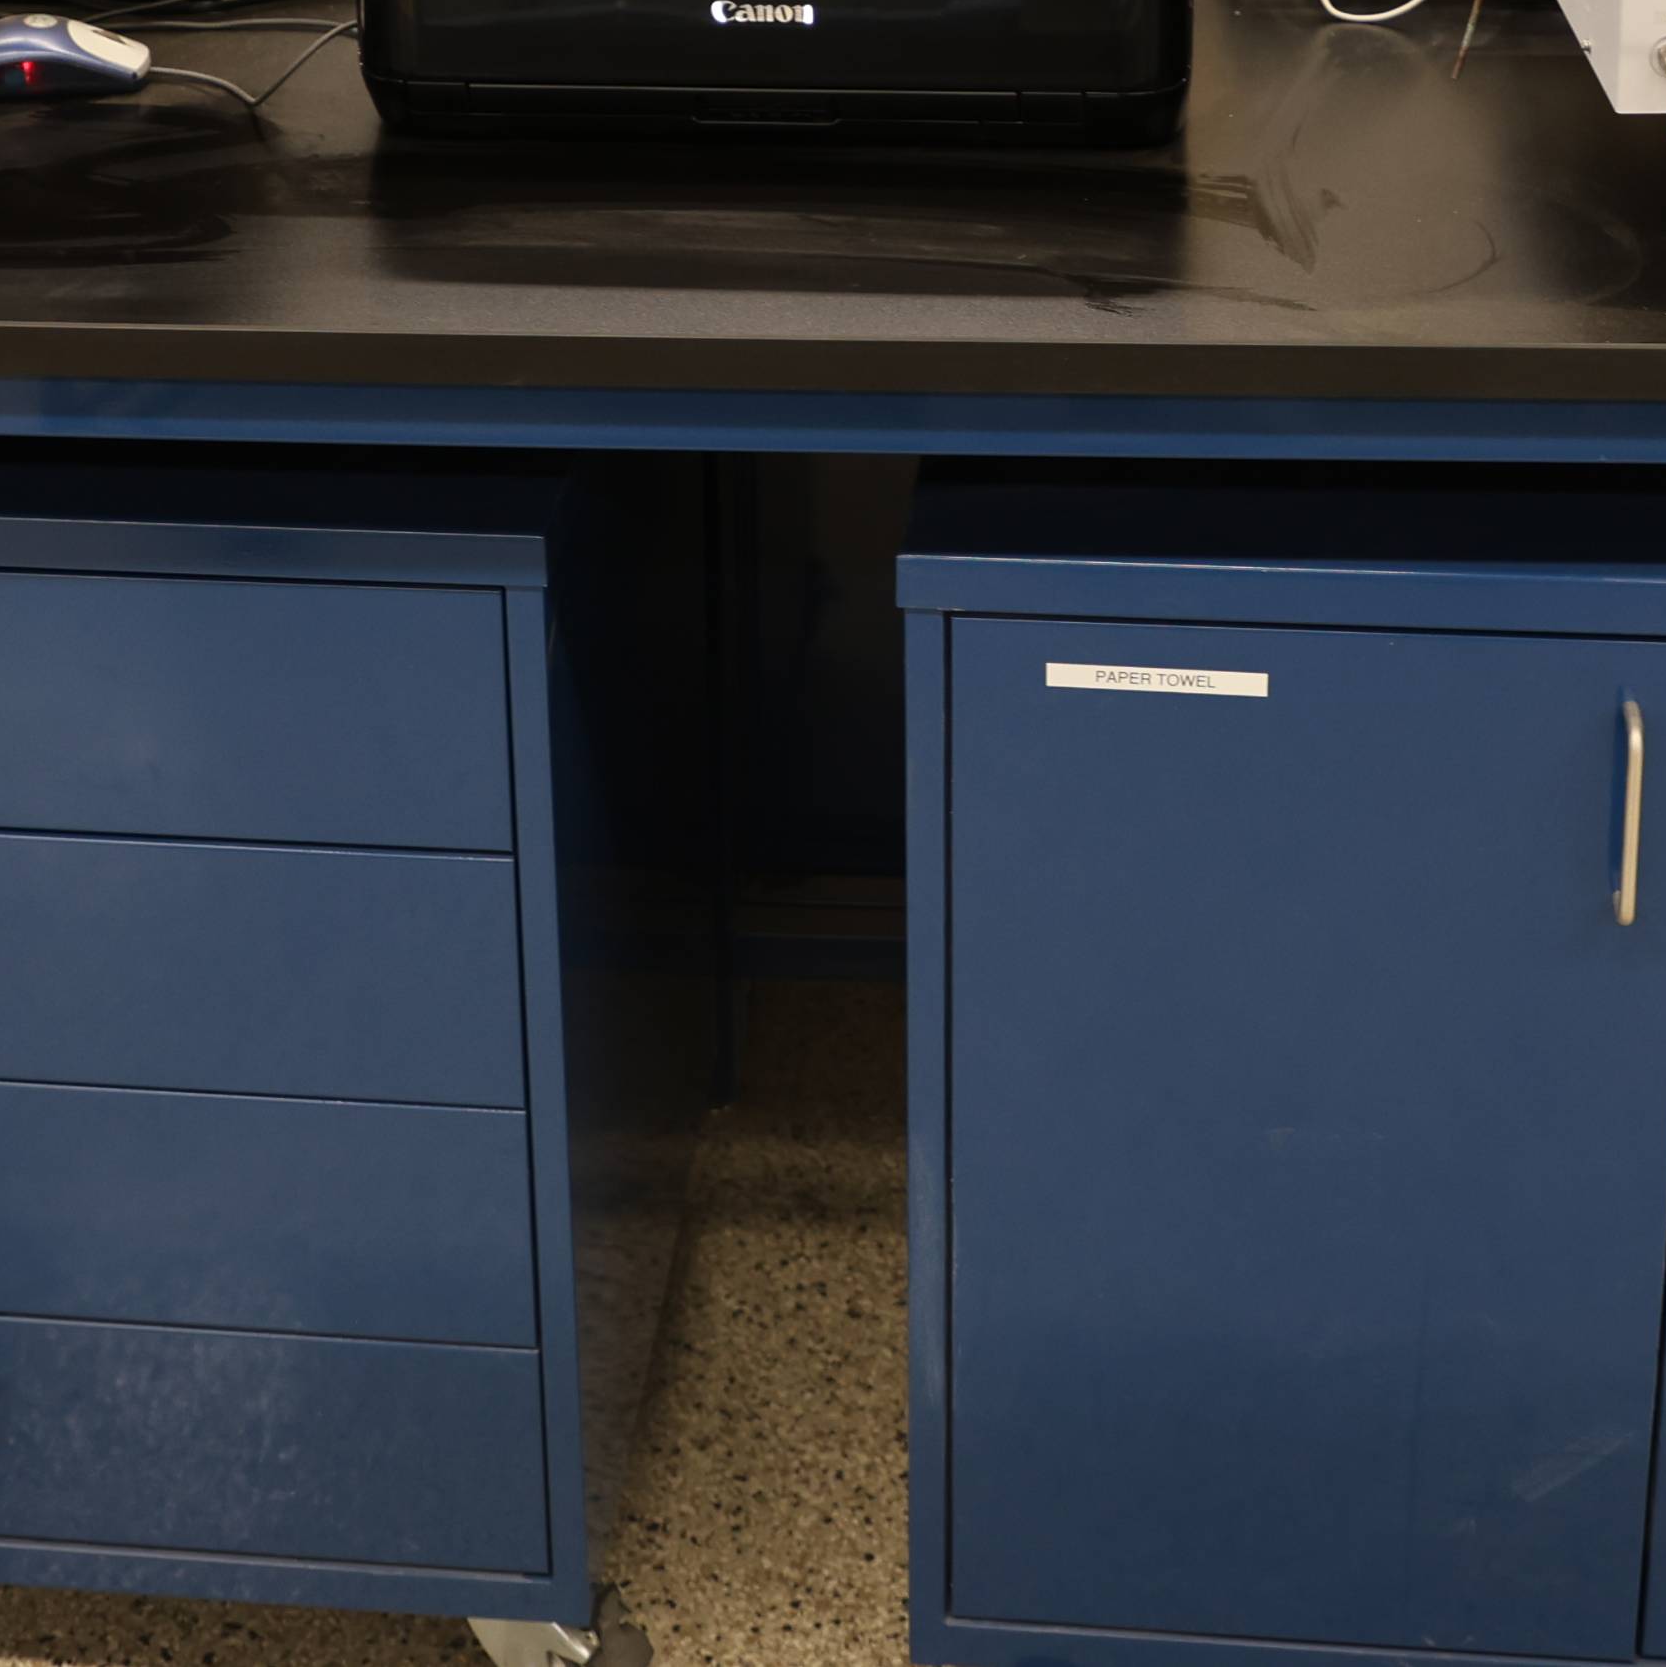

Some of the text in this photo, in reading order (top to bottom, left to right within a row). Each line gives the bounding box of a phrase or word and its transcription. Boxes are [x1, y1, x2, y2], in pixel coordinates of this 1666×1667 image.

[710, 0, 814, 25] Canon
[1095, 670, 1217, 689] PAPER TOWEL
